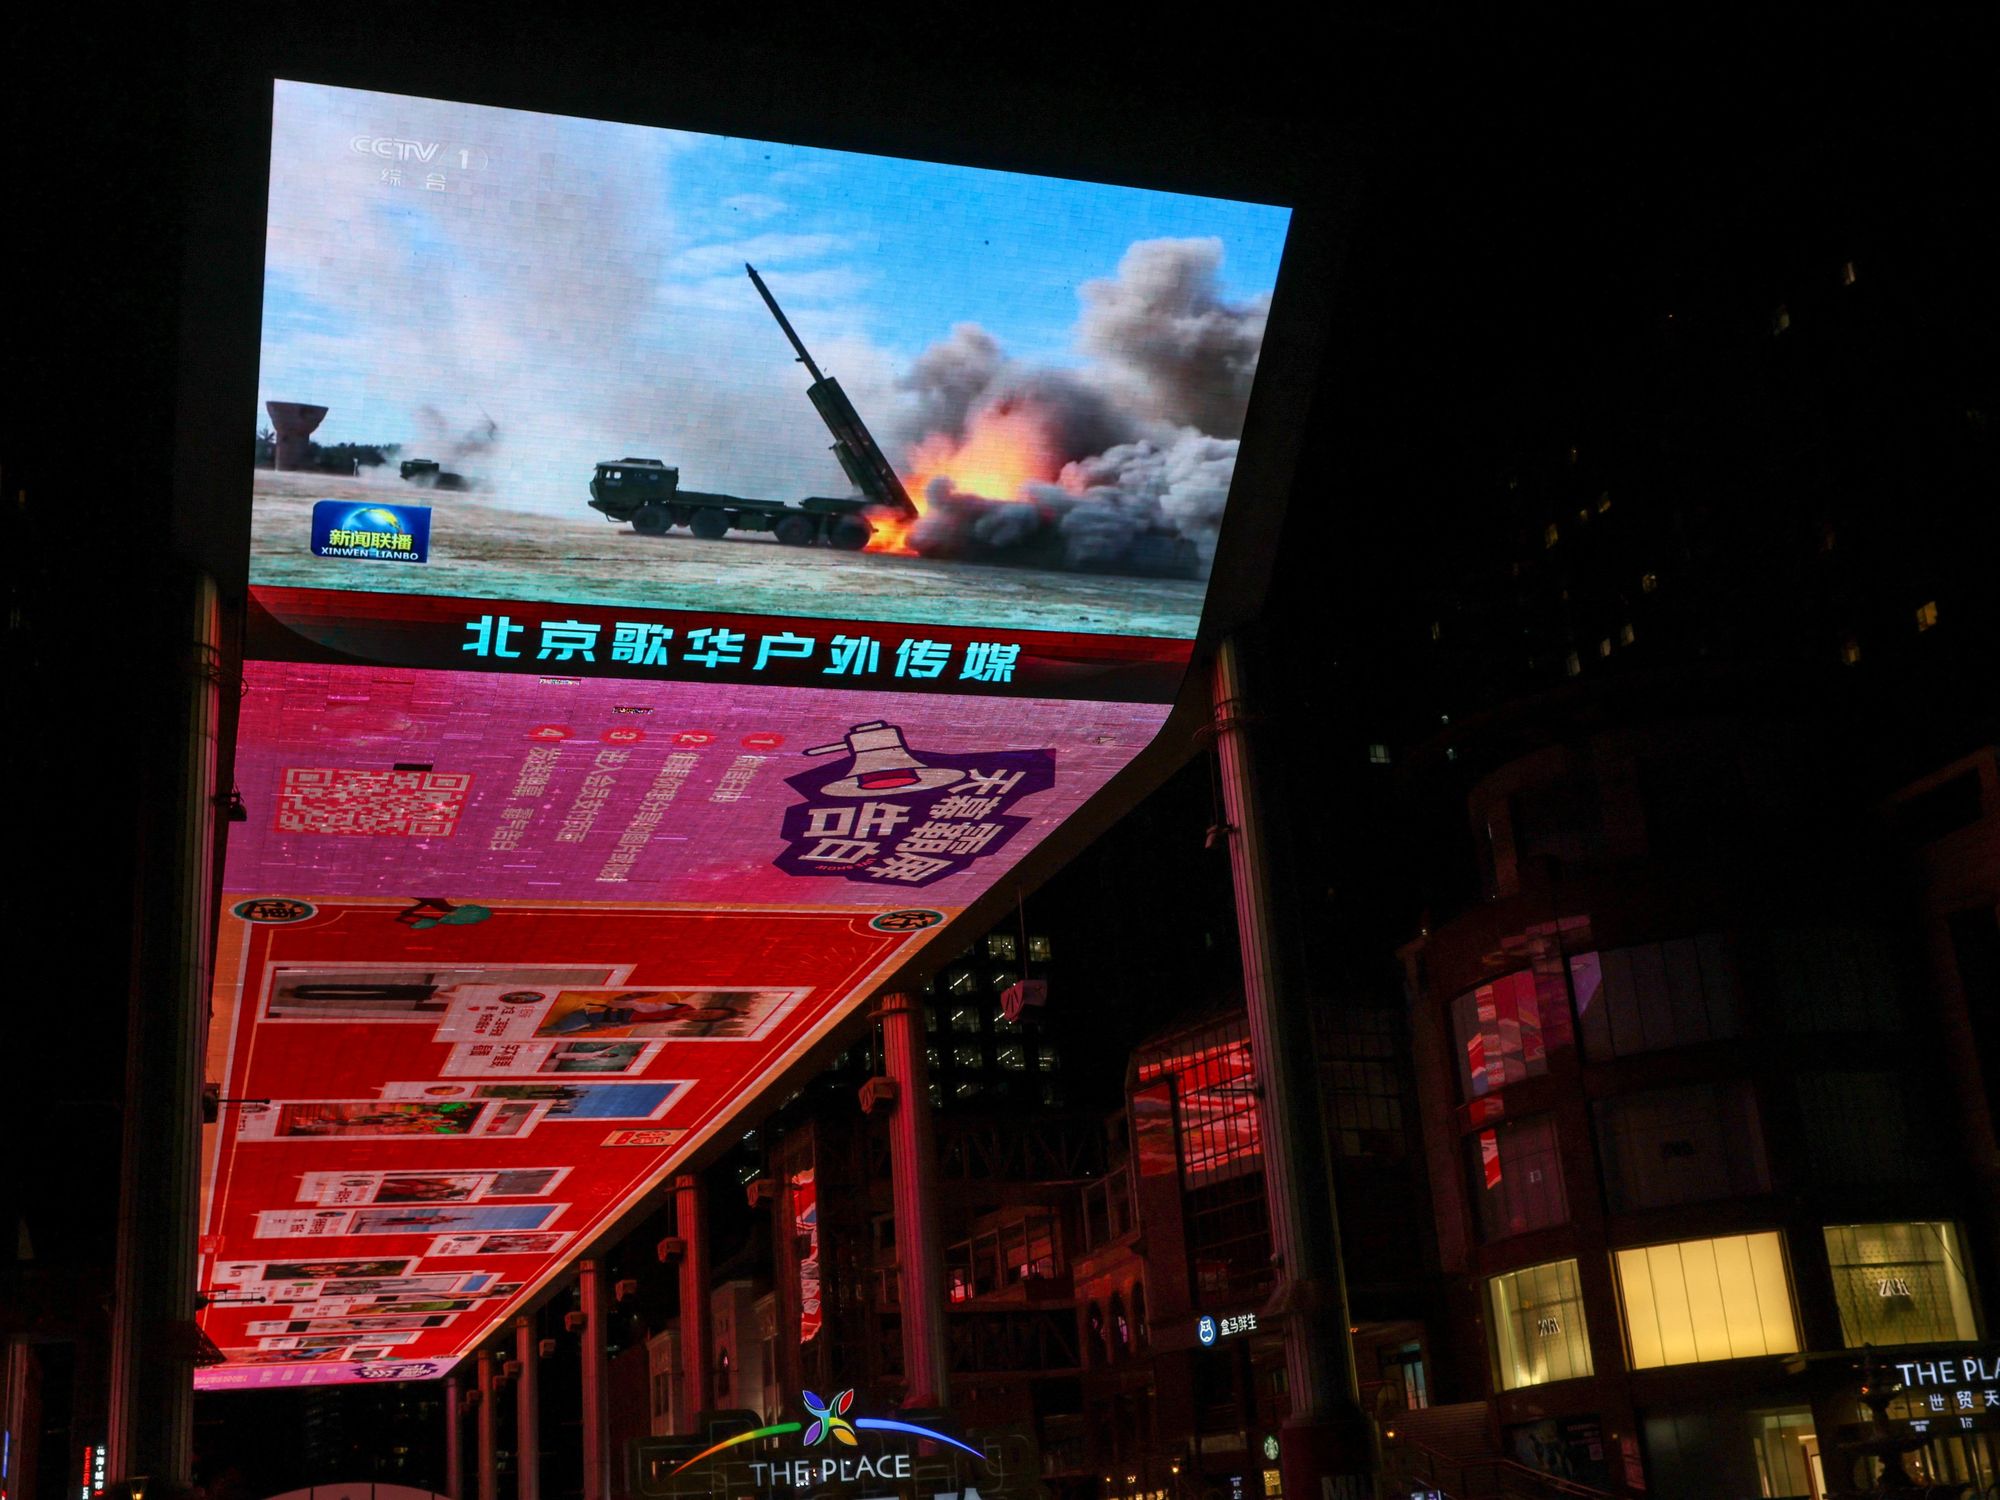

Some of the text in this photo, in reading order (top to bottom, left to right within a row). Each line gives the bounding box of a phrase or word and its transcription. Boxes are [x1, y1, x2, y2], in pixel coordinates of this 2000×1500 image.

[350, 135, 468, 170] CCTV 1
[381, 168, 447, 191] 综合
[329, 529, 412, 551] 新闻联播
[321, 546, 419, 560] XINWEN LIANBO
[462, 614, 1021, 683] 北京歌华户外传媒
[1220, 1313, 1257, 1336] 盒马鲜生
[1895, 1360, 1957, 1387] THE
[749, 1454, 911, 1487] THE PLACE
